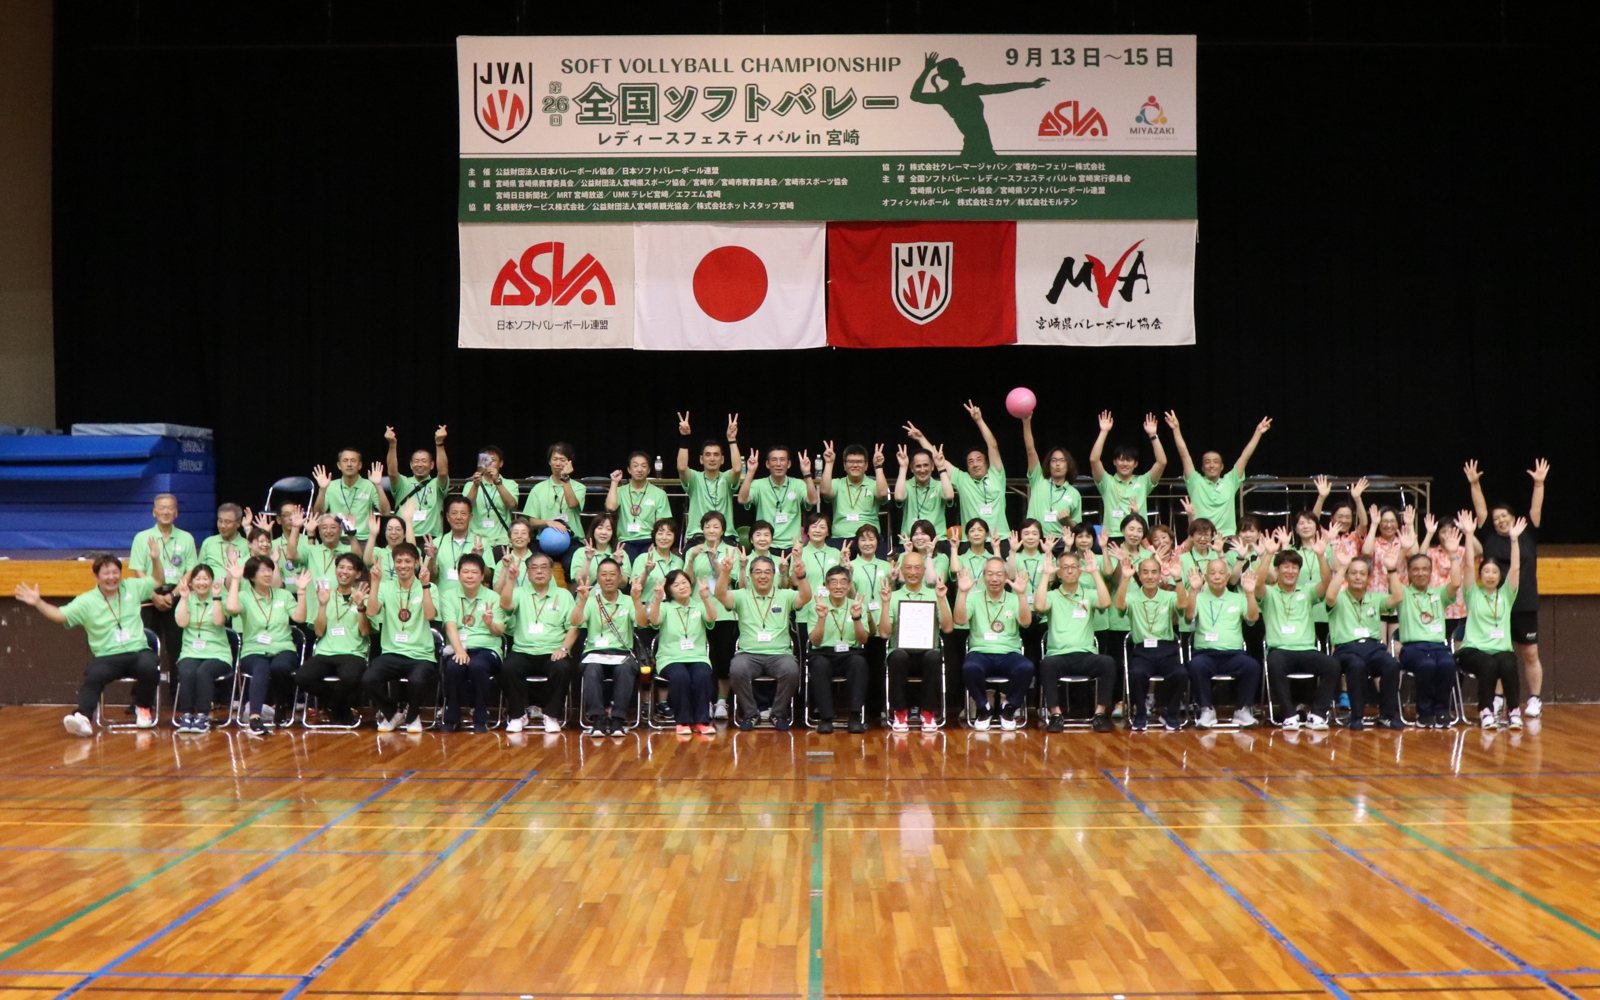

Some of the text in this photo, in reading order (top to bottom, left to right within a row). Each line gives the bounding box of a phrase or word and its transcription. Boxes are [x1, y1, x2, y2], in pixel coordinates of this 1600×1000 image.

[479, 61, 525, 85] JVA
[561, 56, 902, 74] SOFT VOLLYBALL CHAMPIONSHIP
[571, 80, 900, 126] 全国ソフトバレー
[598, 128, 861, 147] レディースフェスティバル in 宮崎
[1129, 127, 1175, 135] MIYAZAKI
[556, 190, 572, 199] MRT
[613, 190, 630, 199] UMK
[900, 245, 942, 267] JVA
[1045, 238, 1151, 309] MVA
[496, 319, 609, 331] 日本ソフトバレーボール連盟
[1035, 315, 1163, 331] 宮崎県バレーボール協会
